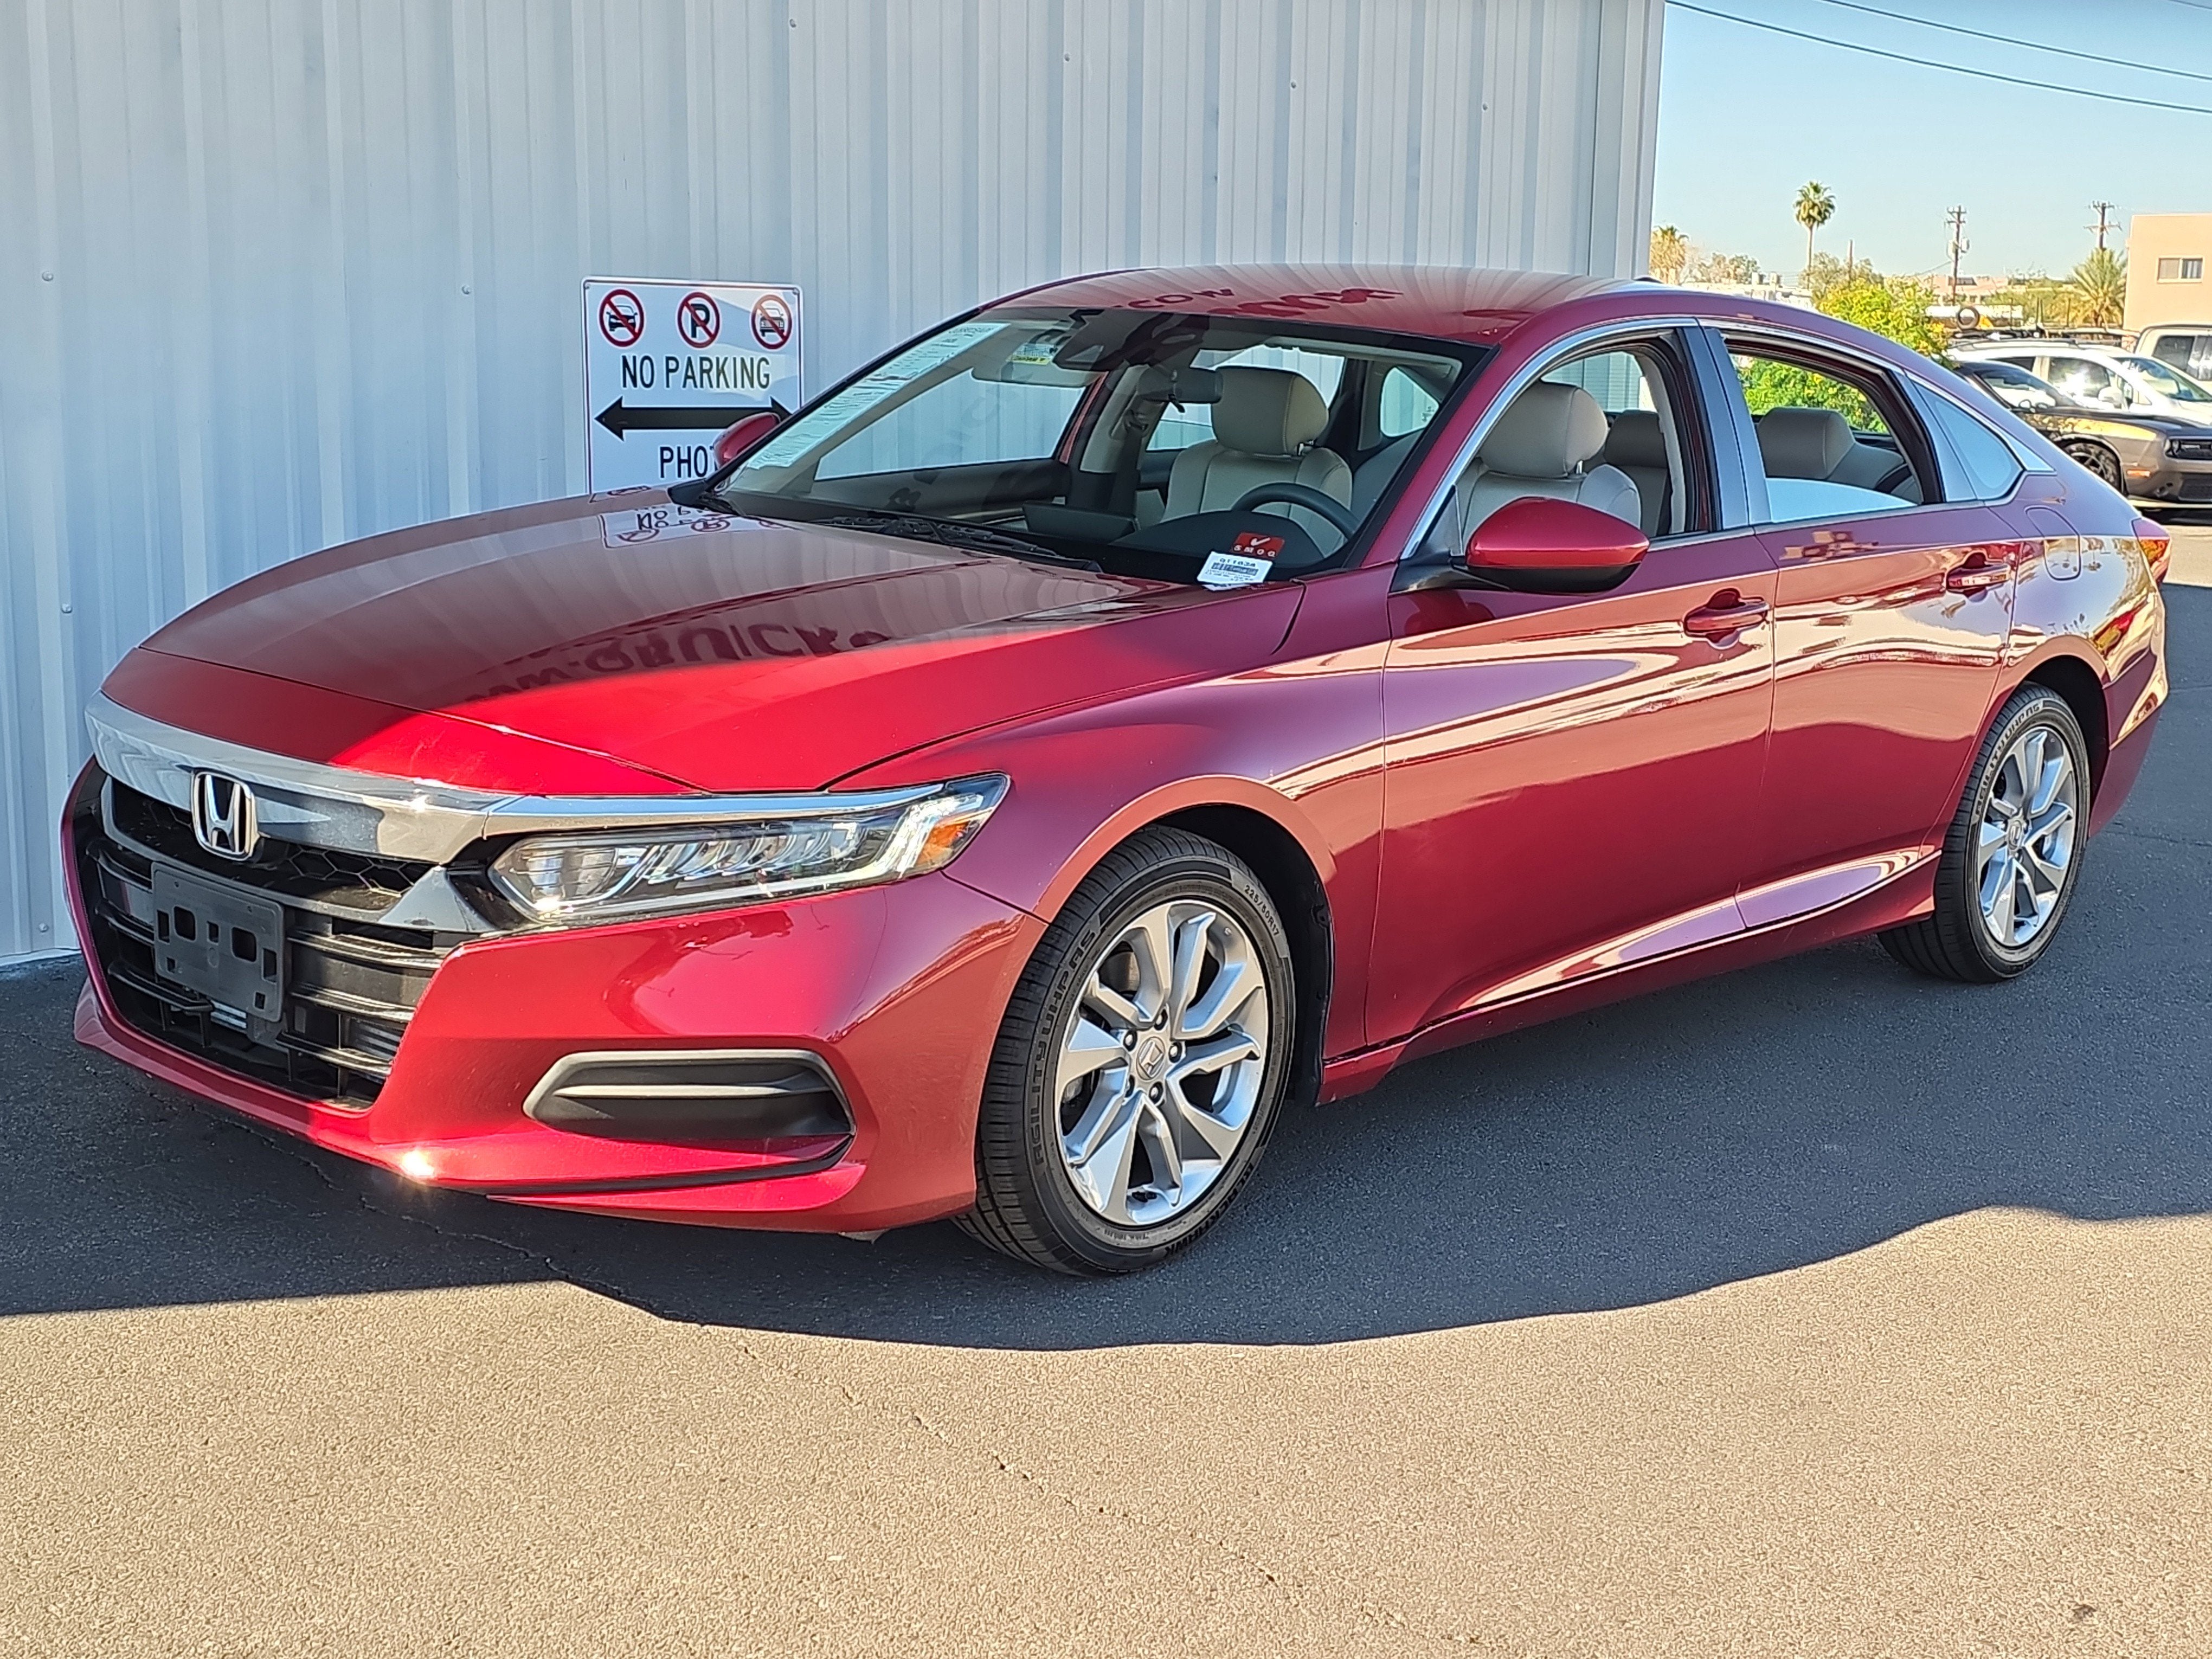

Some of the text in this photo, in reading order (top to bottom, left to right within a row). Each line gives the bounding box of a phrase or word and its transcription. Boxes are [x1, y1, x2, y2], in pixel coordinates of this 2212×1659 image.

[622, 356, 770, 389] NO PARKING
[1244, 884, 1280, 936] 225/50R17
[1030, 1040, 1047, 1167] AGILITY
[1042, 969, 1070, 1036] UHP
[1069, 931, 1096, 972] AS
